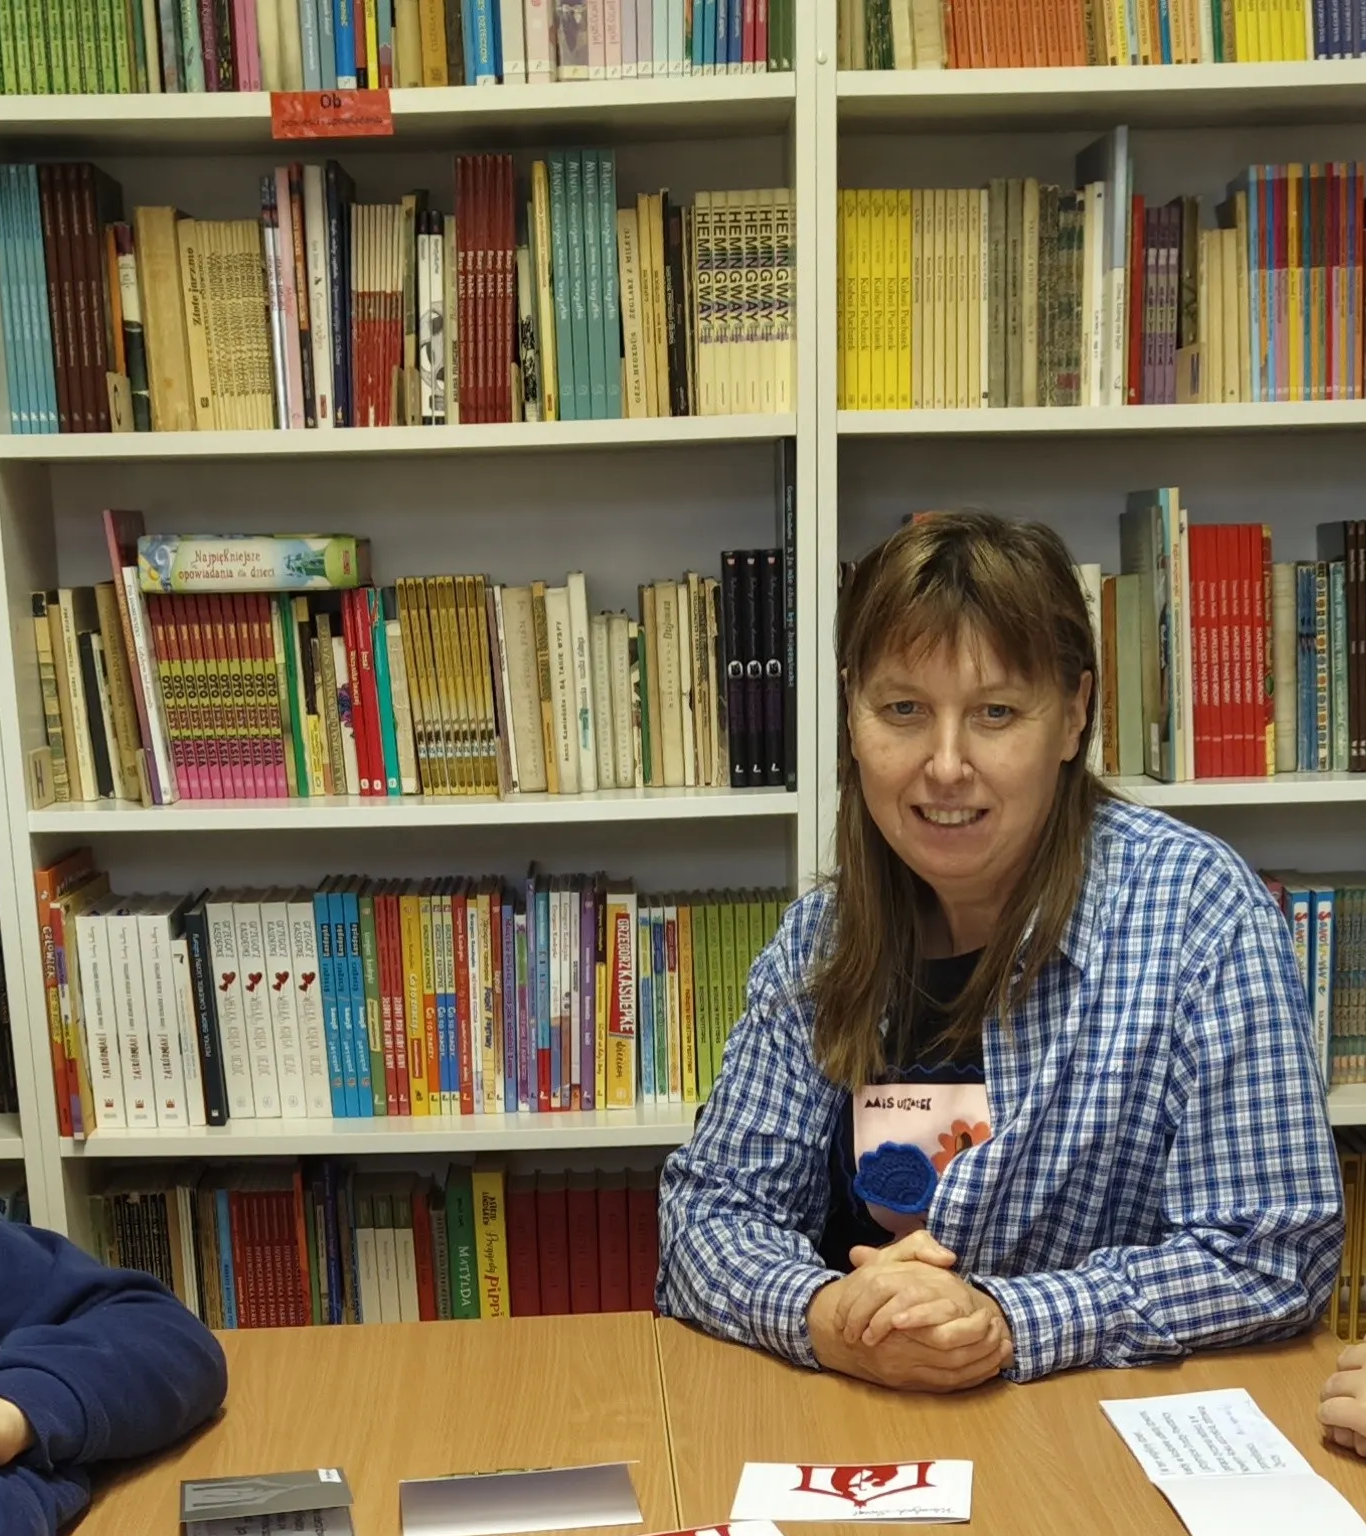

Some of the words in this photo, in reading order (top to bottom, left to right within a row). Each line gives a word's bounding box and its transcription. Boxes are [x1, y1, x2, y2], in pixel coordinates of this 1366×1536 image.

[184, 247, 198, 292] jarzmo
[696, 212, 712, 323] HEMINGWAY
[713, 212, 728, 322] HEMINGWAY
[728, 211, 743, 322] HEMINGWAY
[745, 210, 759, 322] HEMINGWAY
[760, 210, 773, 321] HEMINGWAY
[776, 209, 789, 321] HEMINGWAY
[1157, 286, 1165, 366] ARTYSTA
[179, 569, 234, 581] opowiadania
[250, 568, 275, 578] dzieci
[195, 550, 261, 569] Najpiękniejsze
[162, 675, 173, 700] OTO
[197, 675, 208, 700] OTO
[244, 675, 255, 700] OTO
[614, 918, 632, 968] GRZEGORZ
[618, 970, 636, 1031] KASDEPKE
[458, 1245, 472, 1307] MATYLDA
